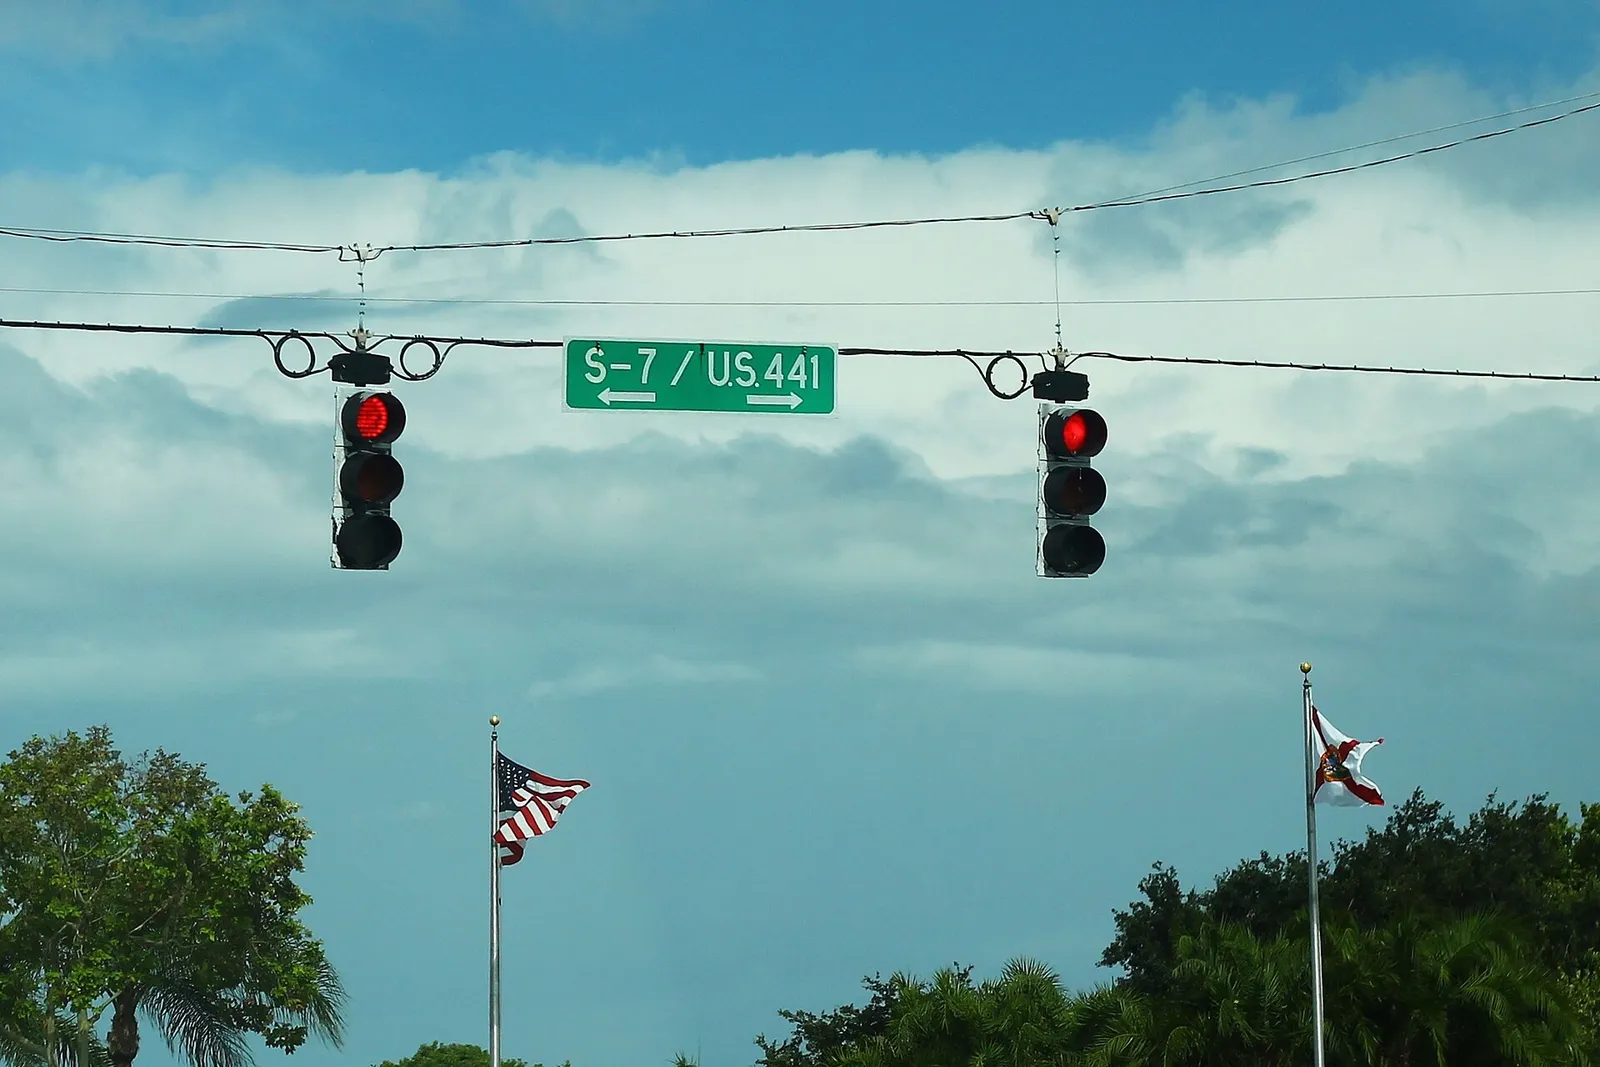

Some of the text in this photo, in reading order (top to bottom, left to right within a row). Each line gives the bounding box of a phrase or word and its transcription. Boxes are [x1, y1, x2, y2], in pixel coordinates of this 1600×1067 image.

[584, 347, 657, 384] S-7
[670, 350, 694, 386] /
[763, 353, 819, 389] 441
